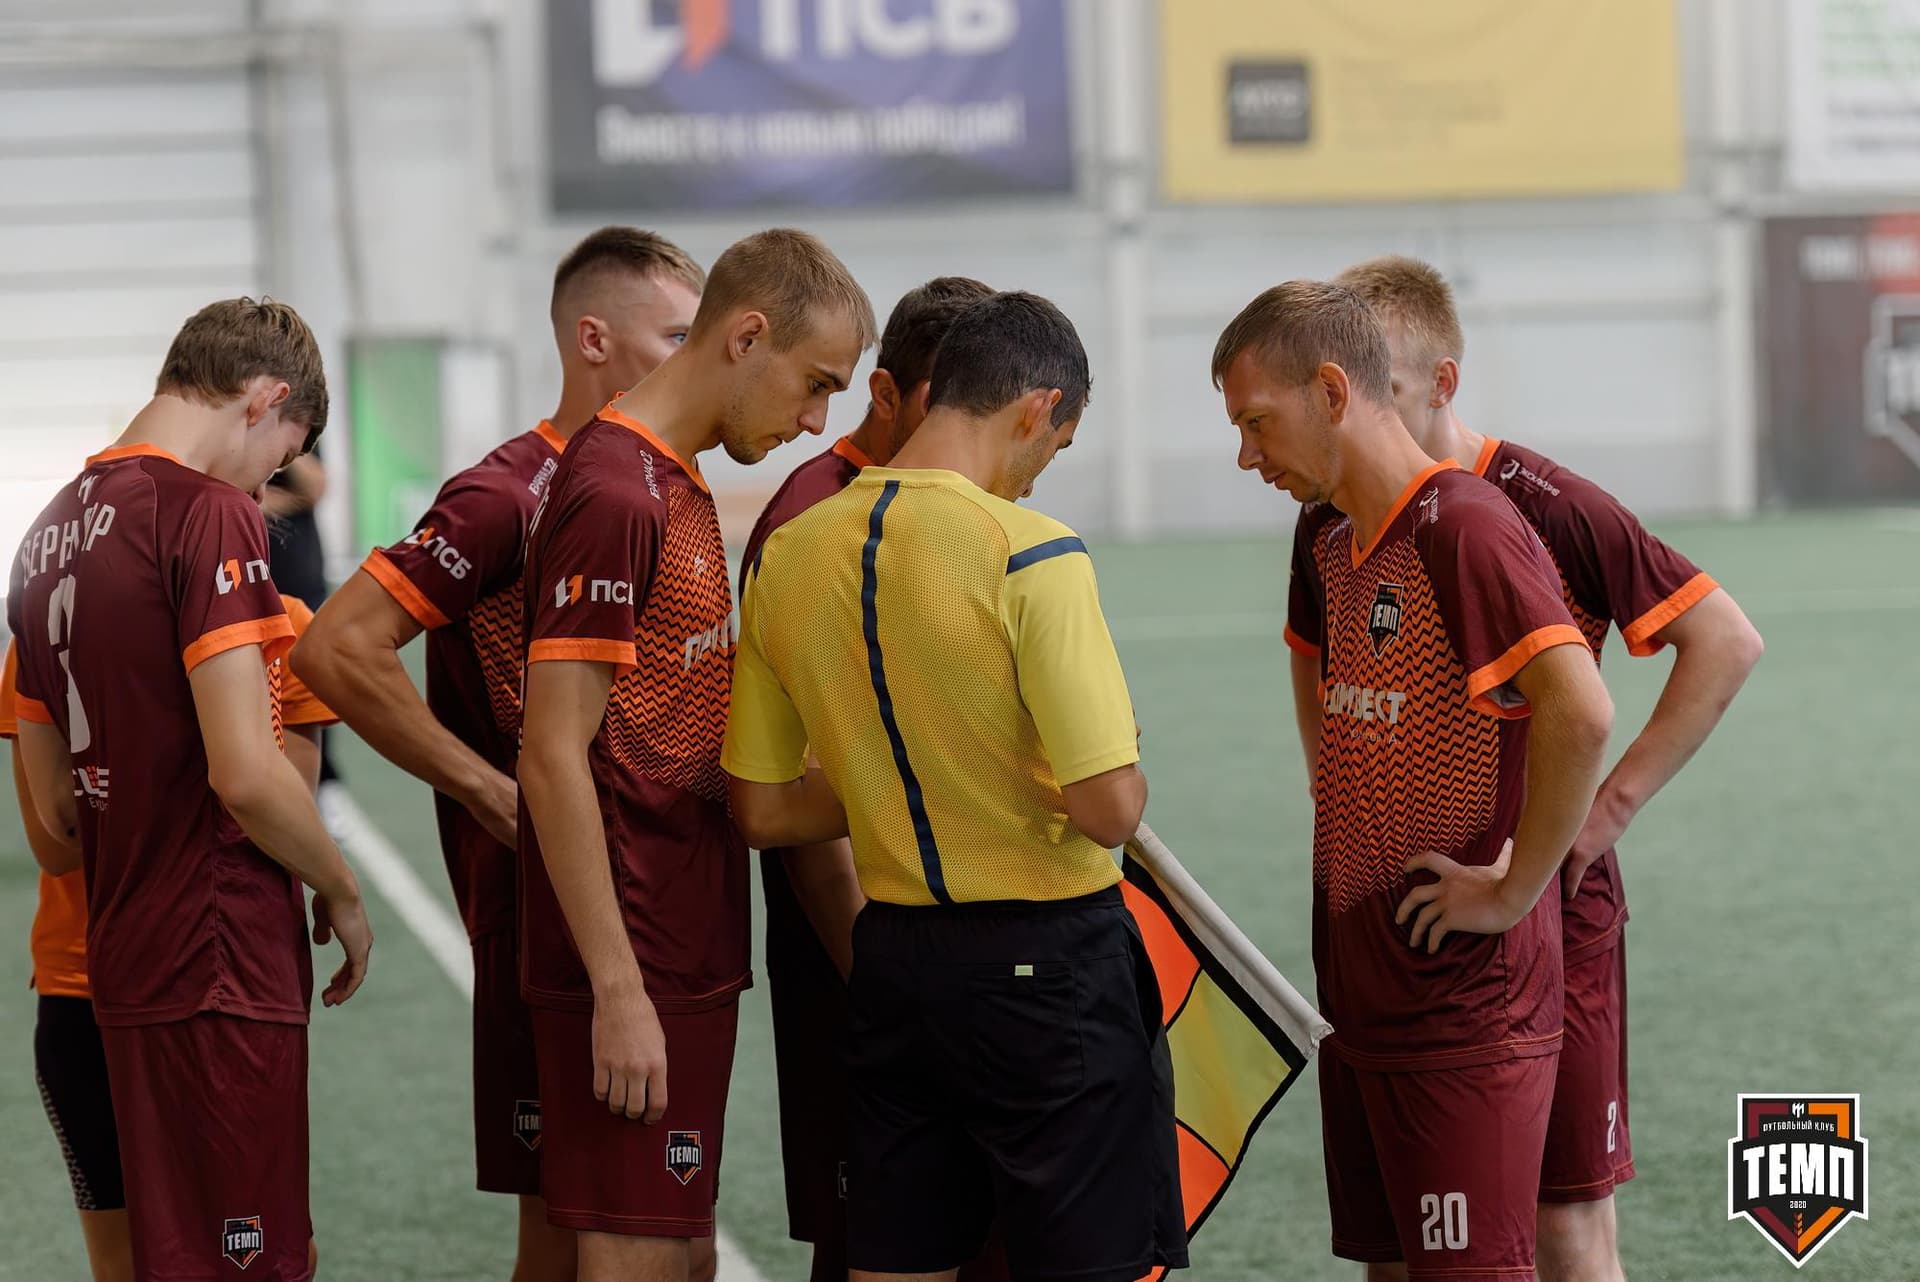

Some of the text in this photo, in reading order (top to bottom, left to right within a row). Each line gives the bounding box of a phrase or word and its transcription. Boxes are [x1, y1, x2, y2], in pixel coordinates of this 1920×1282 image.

[422, 535, 472, 580] ПСБ
[246, 559, 270, 584] П
[517, 1114, 541, 1131] ТЕМ
[670, 1146, 699, 1164] ТЕМП
[1420, 1192, 1468, 1251] 20
[226, 1231, 259, 1251] ТЕМП
